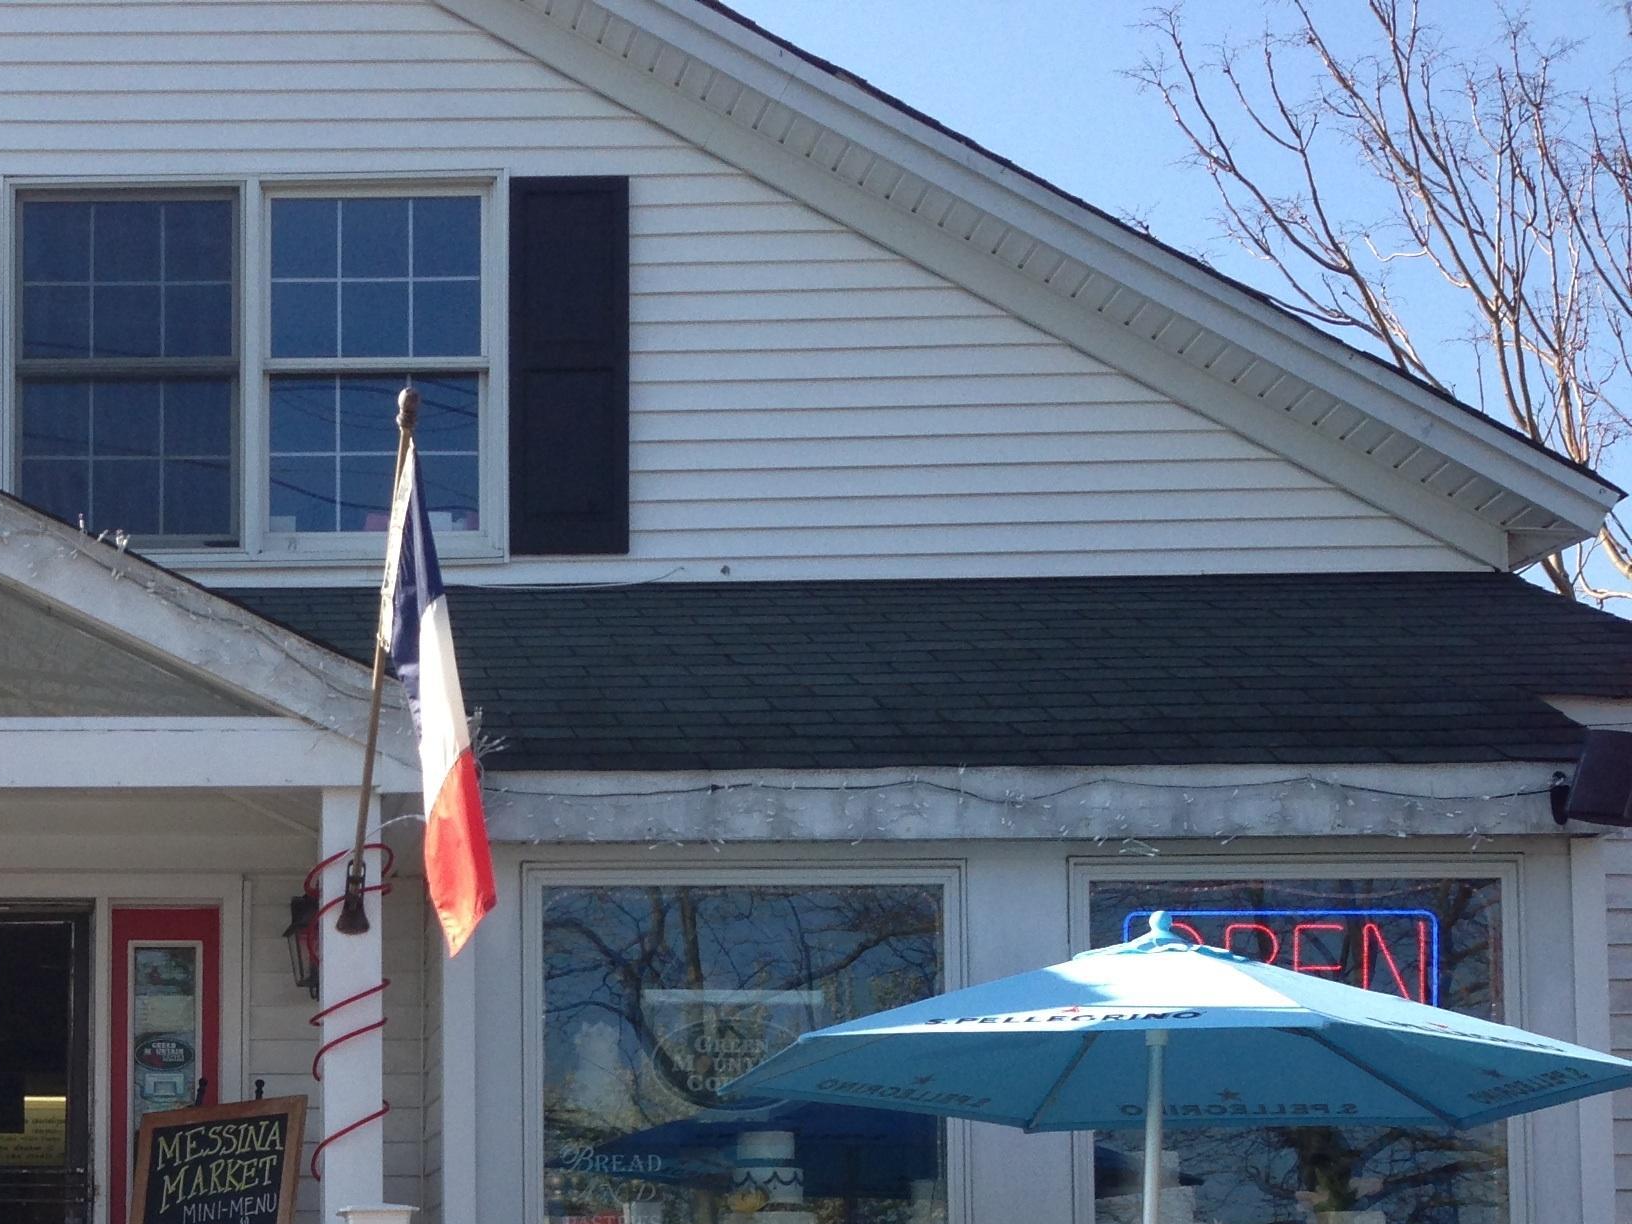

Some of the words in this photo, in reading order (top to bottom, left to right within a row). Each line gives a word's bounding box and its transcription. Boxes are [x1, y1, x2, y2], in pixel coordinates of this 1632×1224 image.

[924, 1009, 1206, 1026] S.PELLEGRINO
[694, 1035, 765, 1054] GREEN
[157, 1120, 284, 1171] MESSINA
[560, 1146, 662, 1173] BREAD
[159, 1155, 278, 1214] MARKET
